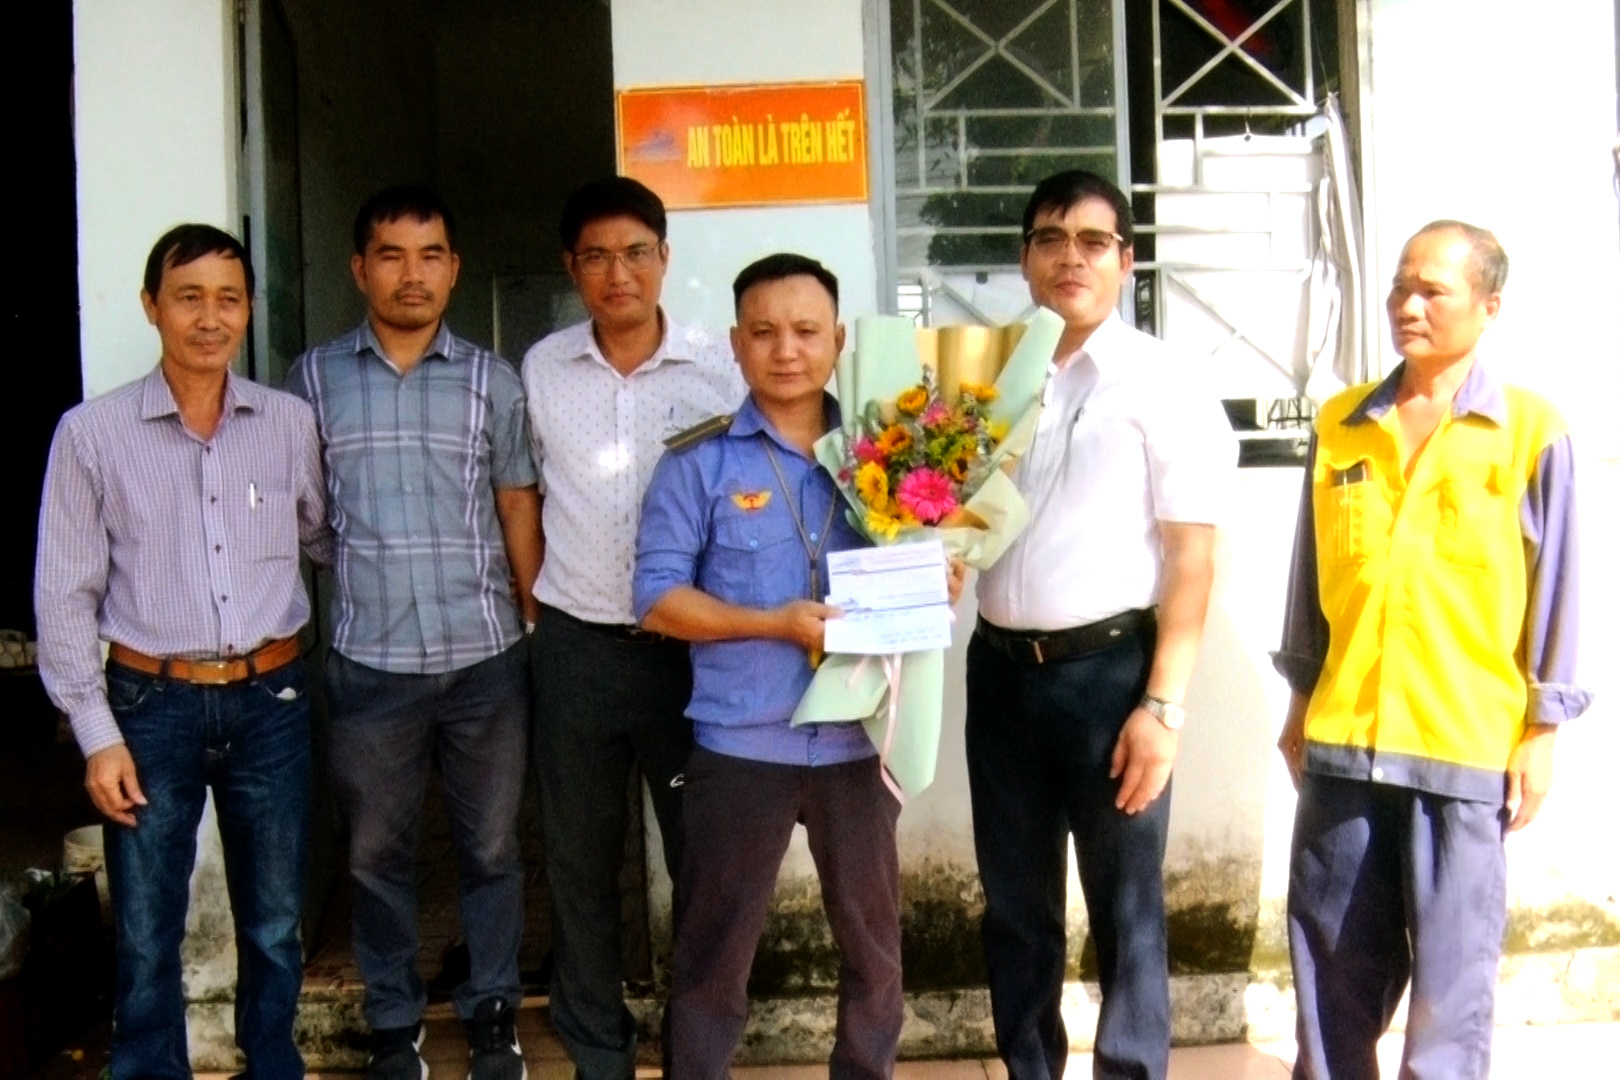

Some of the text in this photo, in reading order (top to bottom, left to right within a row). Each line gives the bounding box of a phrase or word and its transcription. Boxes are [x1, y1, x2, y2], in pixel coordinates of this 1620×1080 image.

[687, 107, 856, 168] AN TOÀN LÀ TRÊN HẾT
